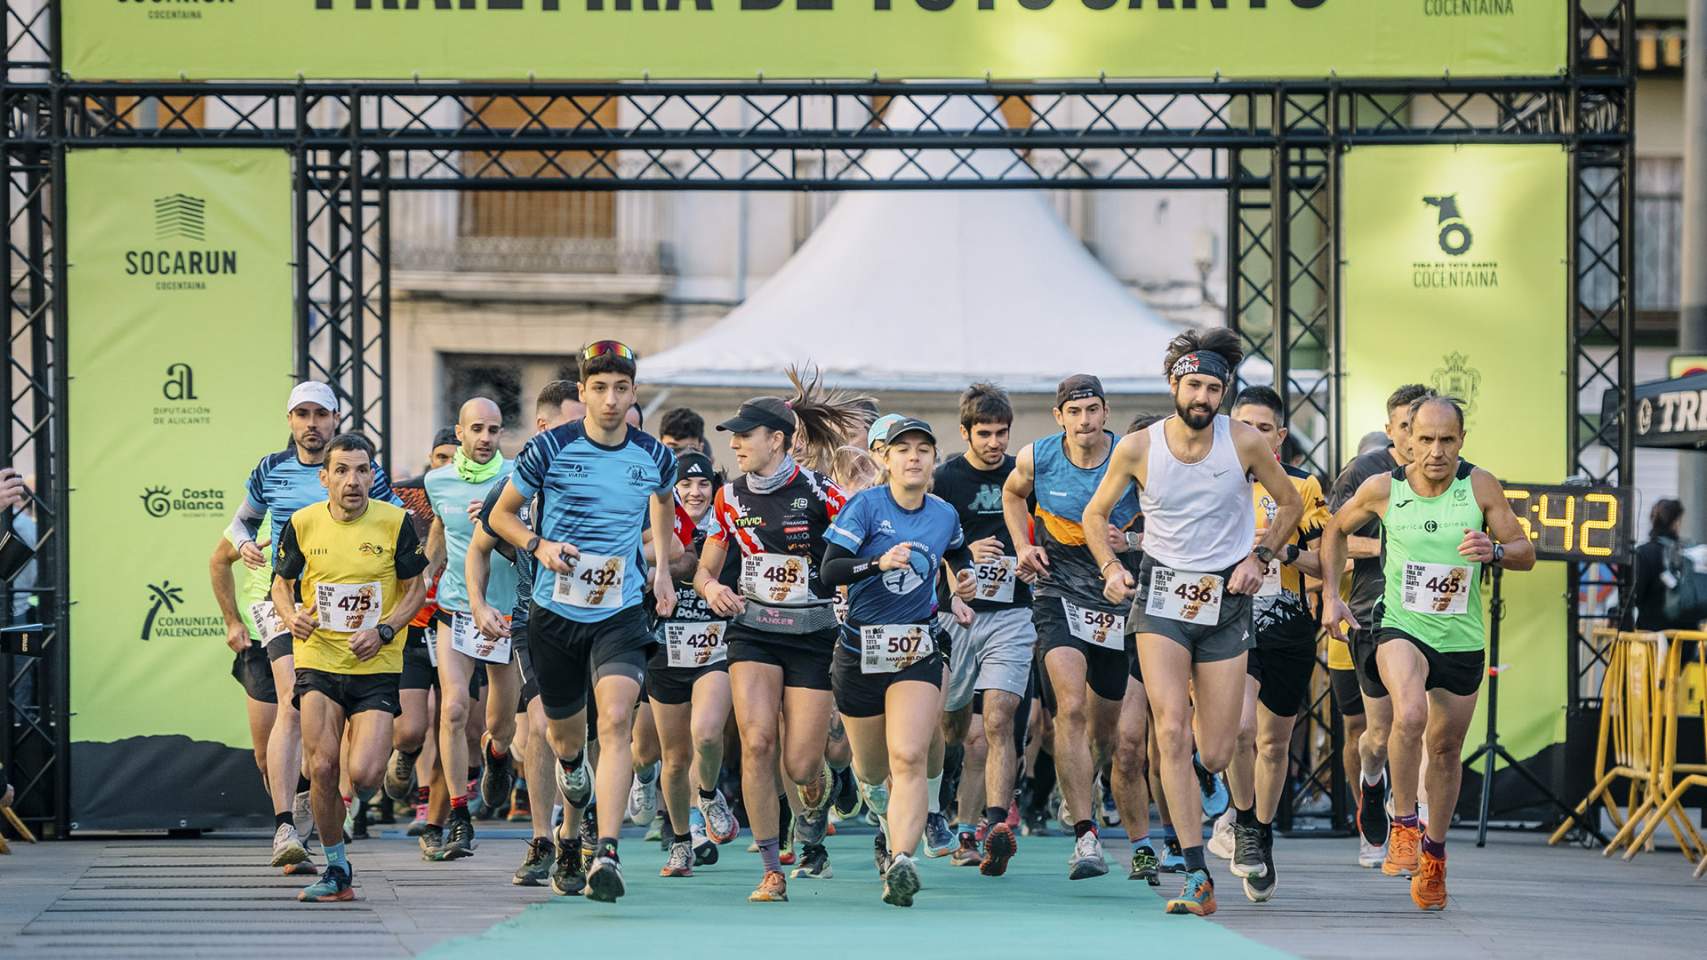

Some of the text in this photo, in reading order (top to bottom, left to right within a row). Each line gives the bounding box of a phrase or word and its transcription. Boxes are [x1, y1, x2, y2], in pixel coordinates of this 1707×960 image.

[1423, 0, 1514, 16] COCENTAINA
[125, 250, 237, 275] SOCARUN
[155, 281, 206, 290] COCENTAINA
[1413, 271, 1499, 288] COCENTAINA
[182, 488, 224, 499] Costa
[173, 499, 224, 510] Blanca
[580, 568, 616, 586] 432
[763, 566, 798, 583] 485
[977, 566, 1007, 582] 552
[1174, 583, 1211, 603] 436
[1426, 577, 1460, 593] 465
[337, 595, 371, 611] 475
[158, 617, 224, 627] COMUNITAT
[1084, 611, 1115, 628] 549
[155, 627, 226, 637] VALENCIANA
[686, 634, 718, 648] 420
[888, 637, 922, 653] 507
